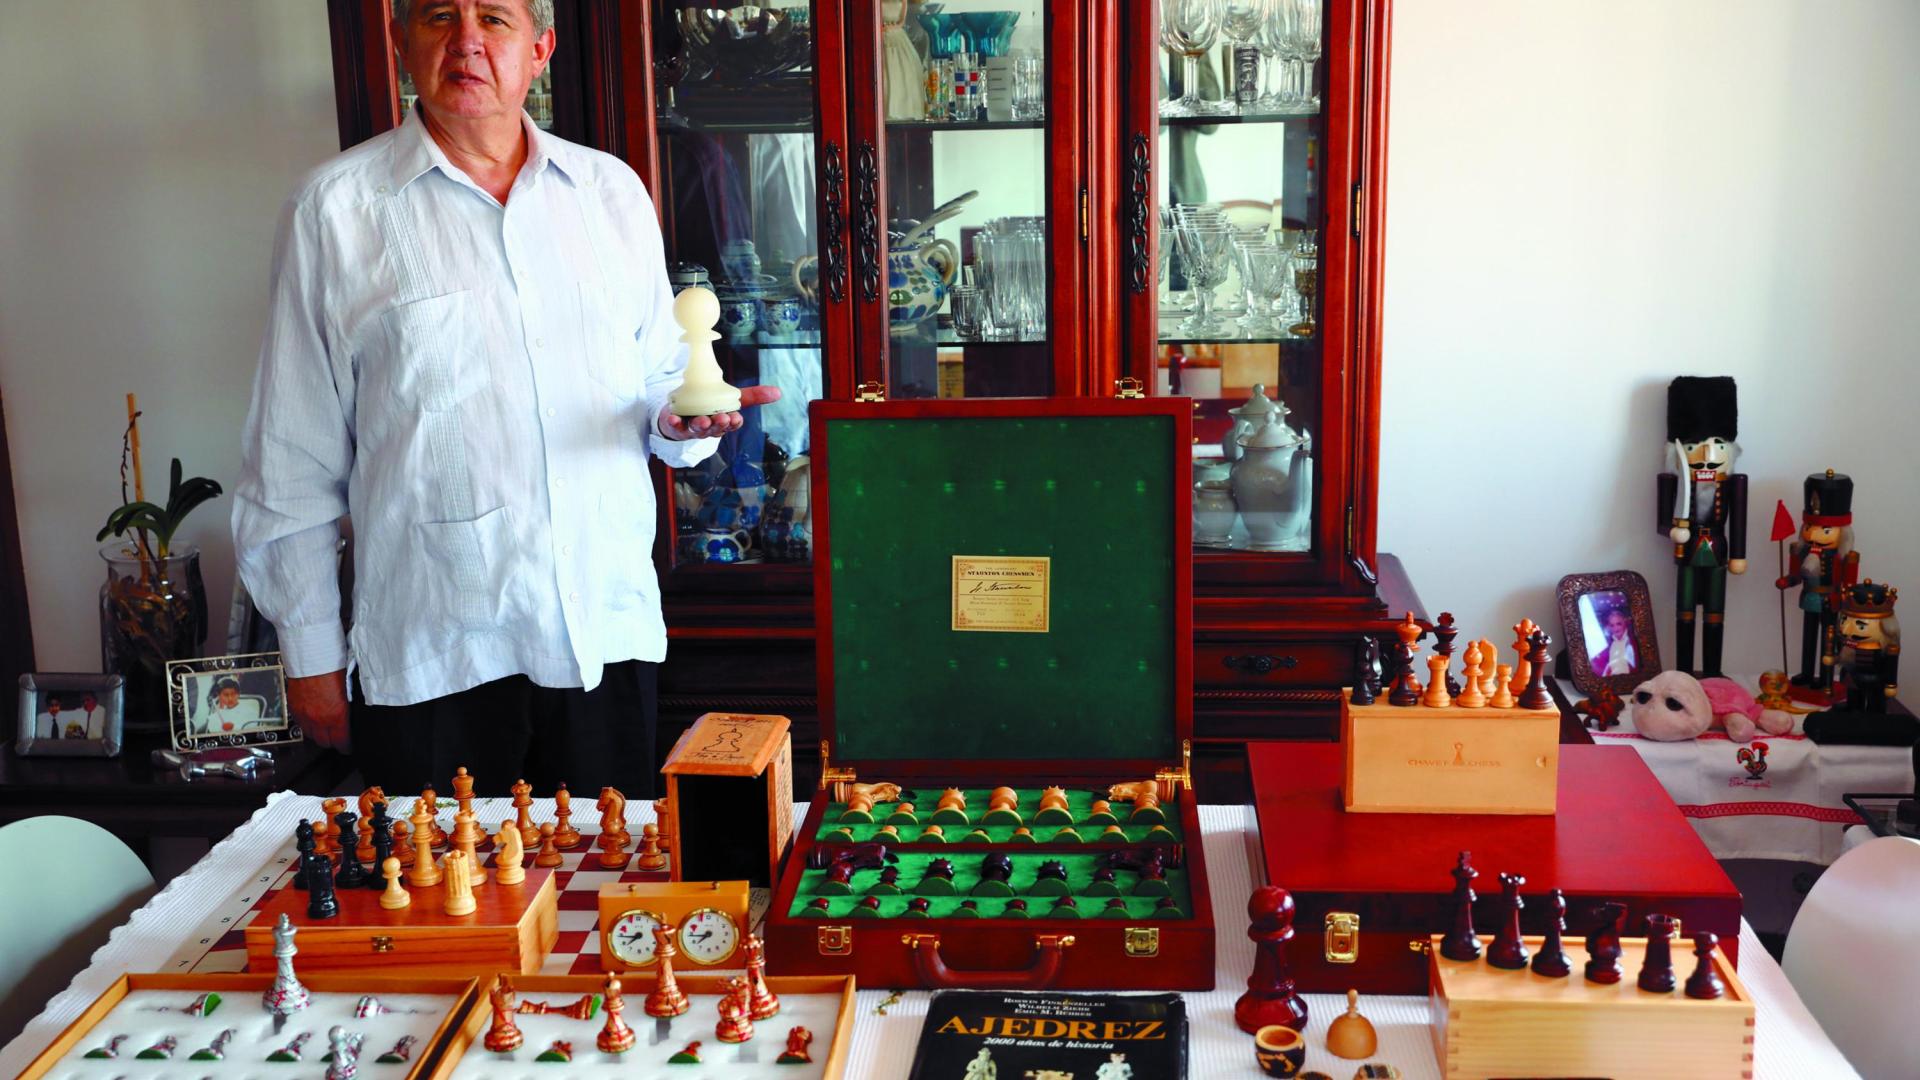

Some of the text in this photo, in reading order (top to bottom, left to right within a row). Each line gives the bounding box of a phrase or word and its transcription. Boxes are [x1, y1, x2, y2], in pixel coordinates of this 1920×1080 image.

[178, 960, 189, 968] 7
[936, 1015, 1166, 1040] AJEDREZ
[983, 1037, 1114, 1049] 2000 años de historia
